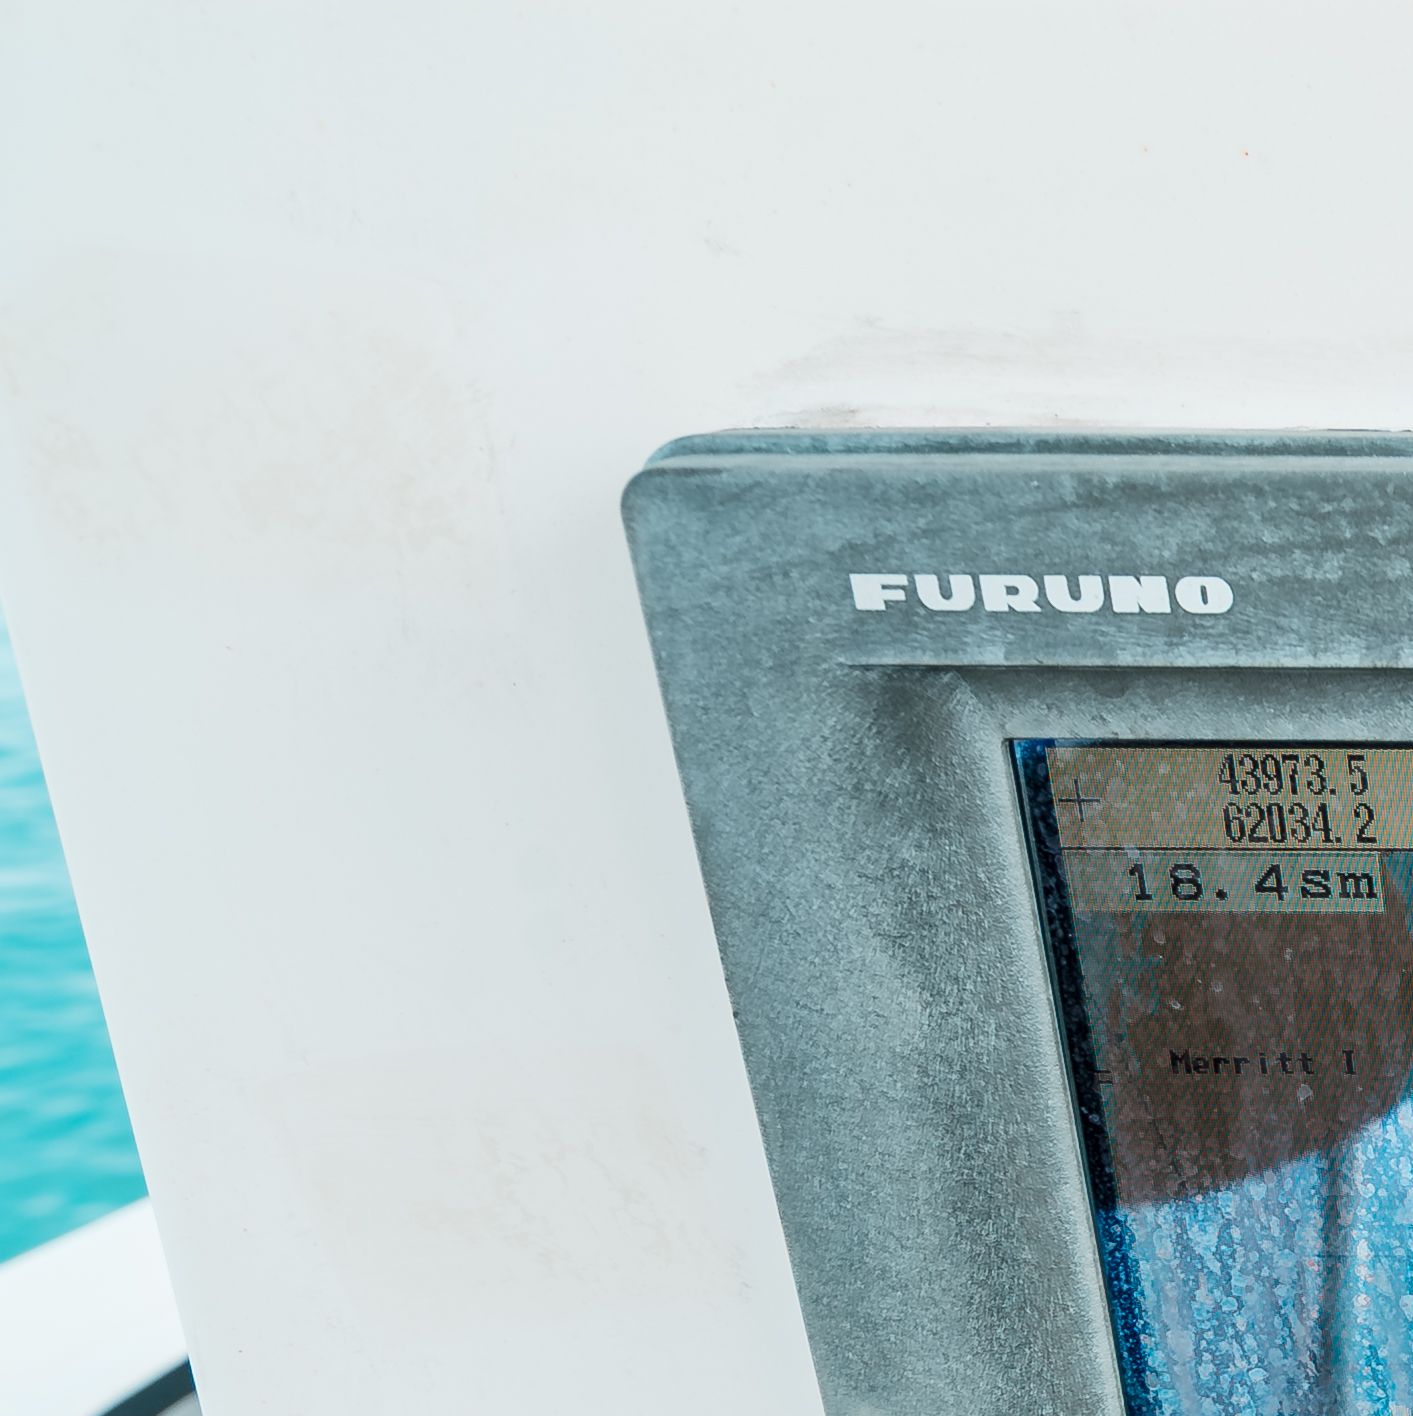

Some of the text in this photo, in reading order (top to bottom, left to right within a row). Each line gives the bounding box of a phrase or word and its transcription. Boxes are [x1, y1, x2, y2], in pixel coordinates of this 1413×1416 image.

[849, 573, 1234, 614] FURUNO
[1219, 754, 1368, 796] 43973.5
[1224, 802, 1377, 844] 62034.2
[1128, 863, 1378, 901] 18.4sm
[1168, 1049, 1357, 1075] Merritt I
